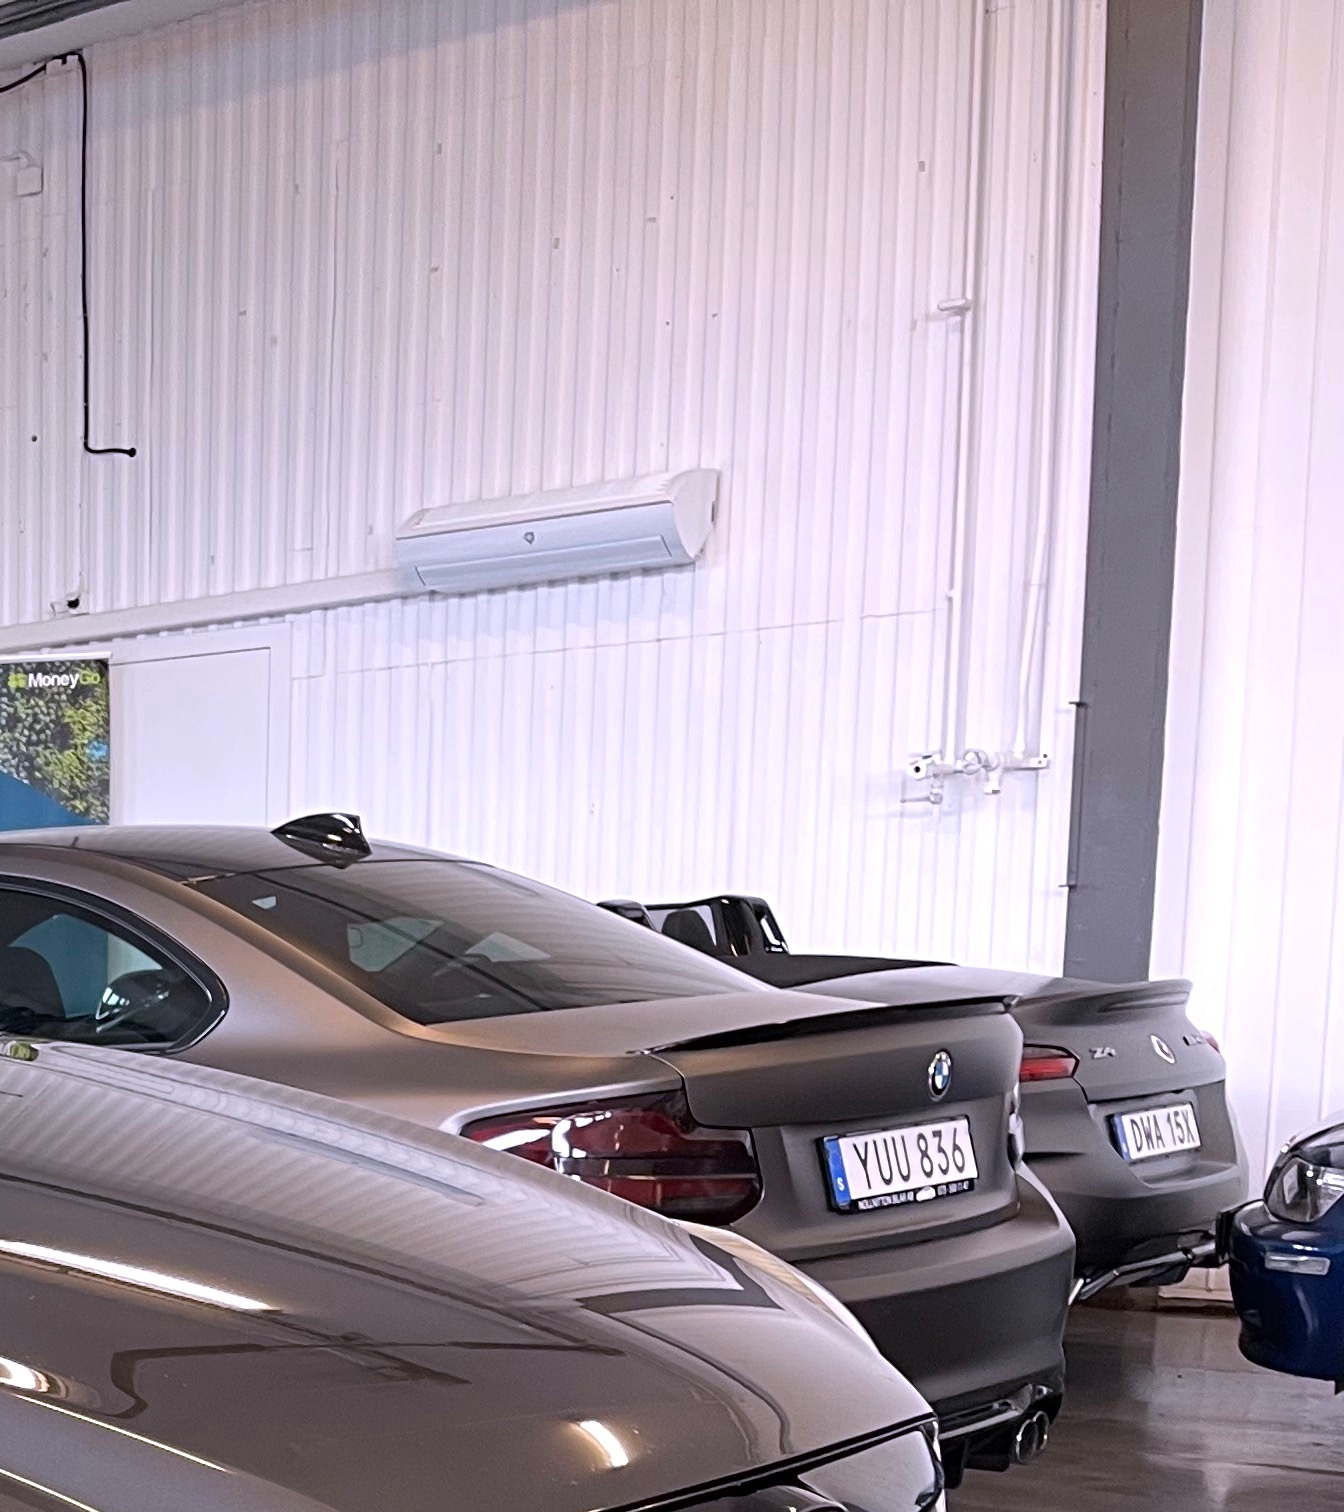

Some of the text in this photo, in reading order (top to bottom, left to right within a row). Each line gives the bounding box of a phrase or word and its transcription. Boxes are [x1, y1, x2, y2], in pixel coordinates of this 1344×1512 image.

[28, 671, 101, 689] MoneyGo
[1130, 1110, 1196, 1153] DWA 15X
[852, 1127, 966, 1190] YUU 836
[836, 1177, 845, 1191] S
